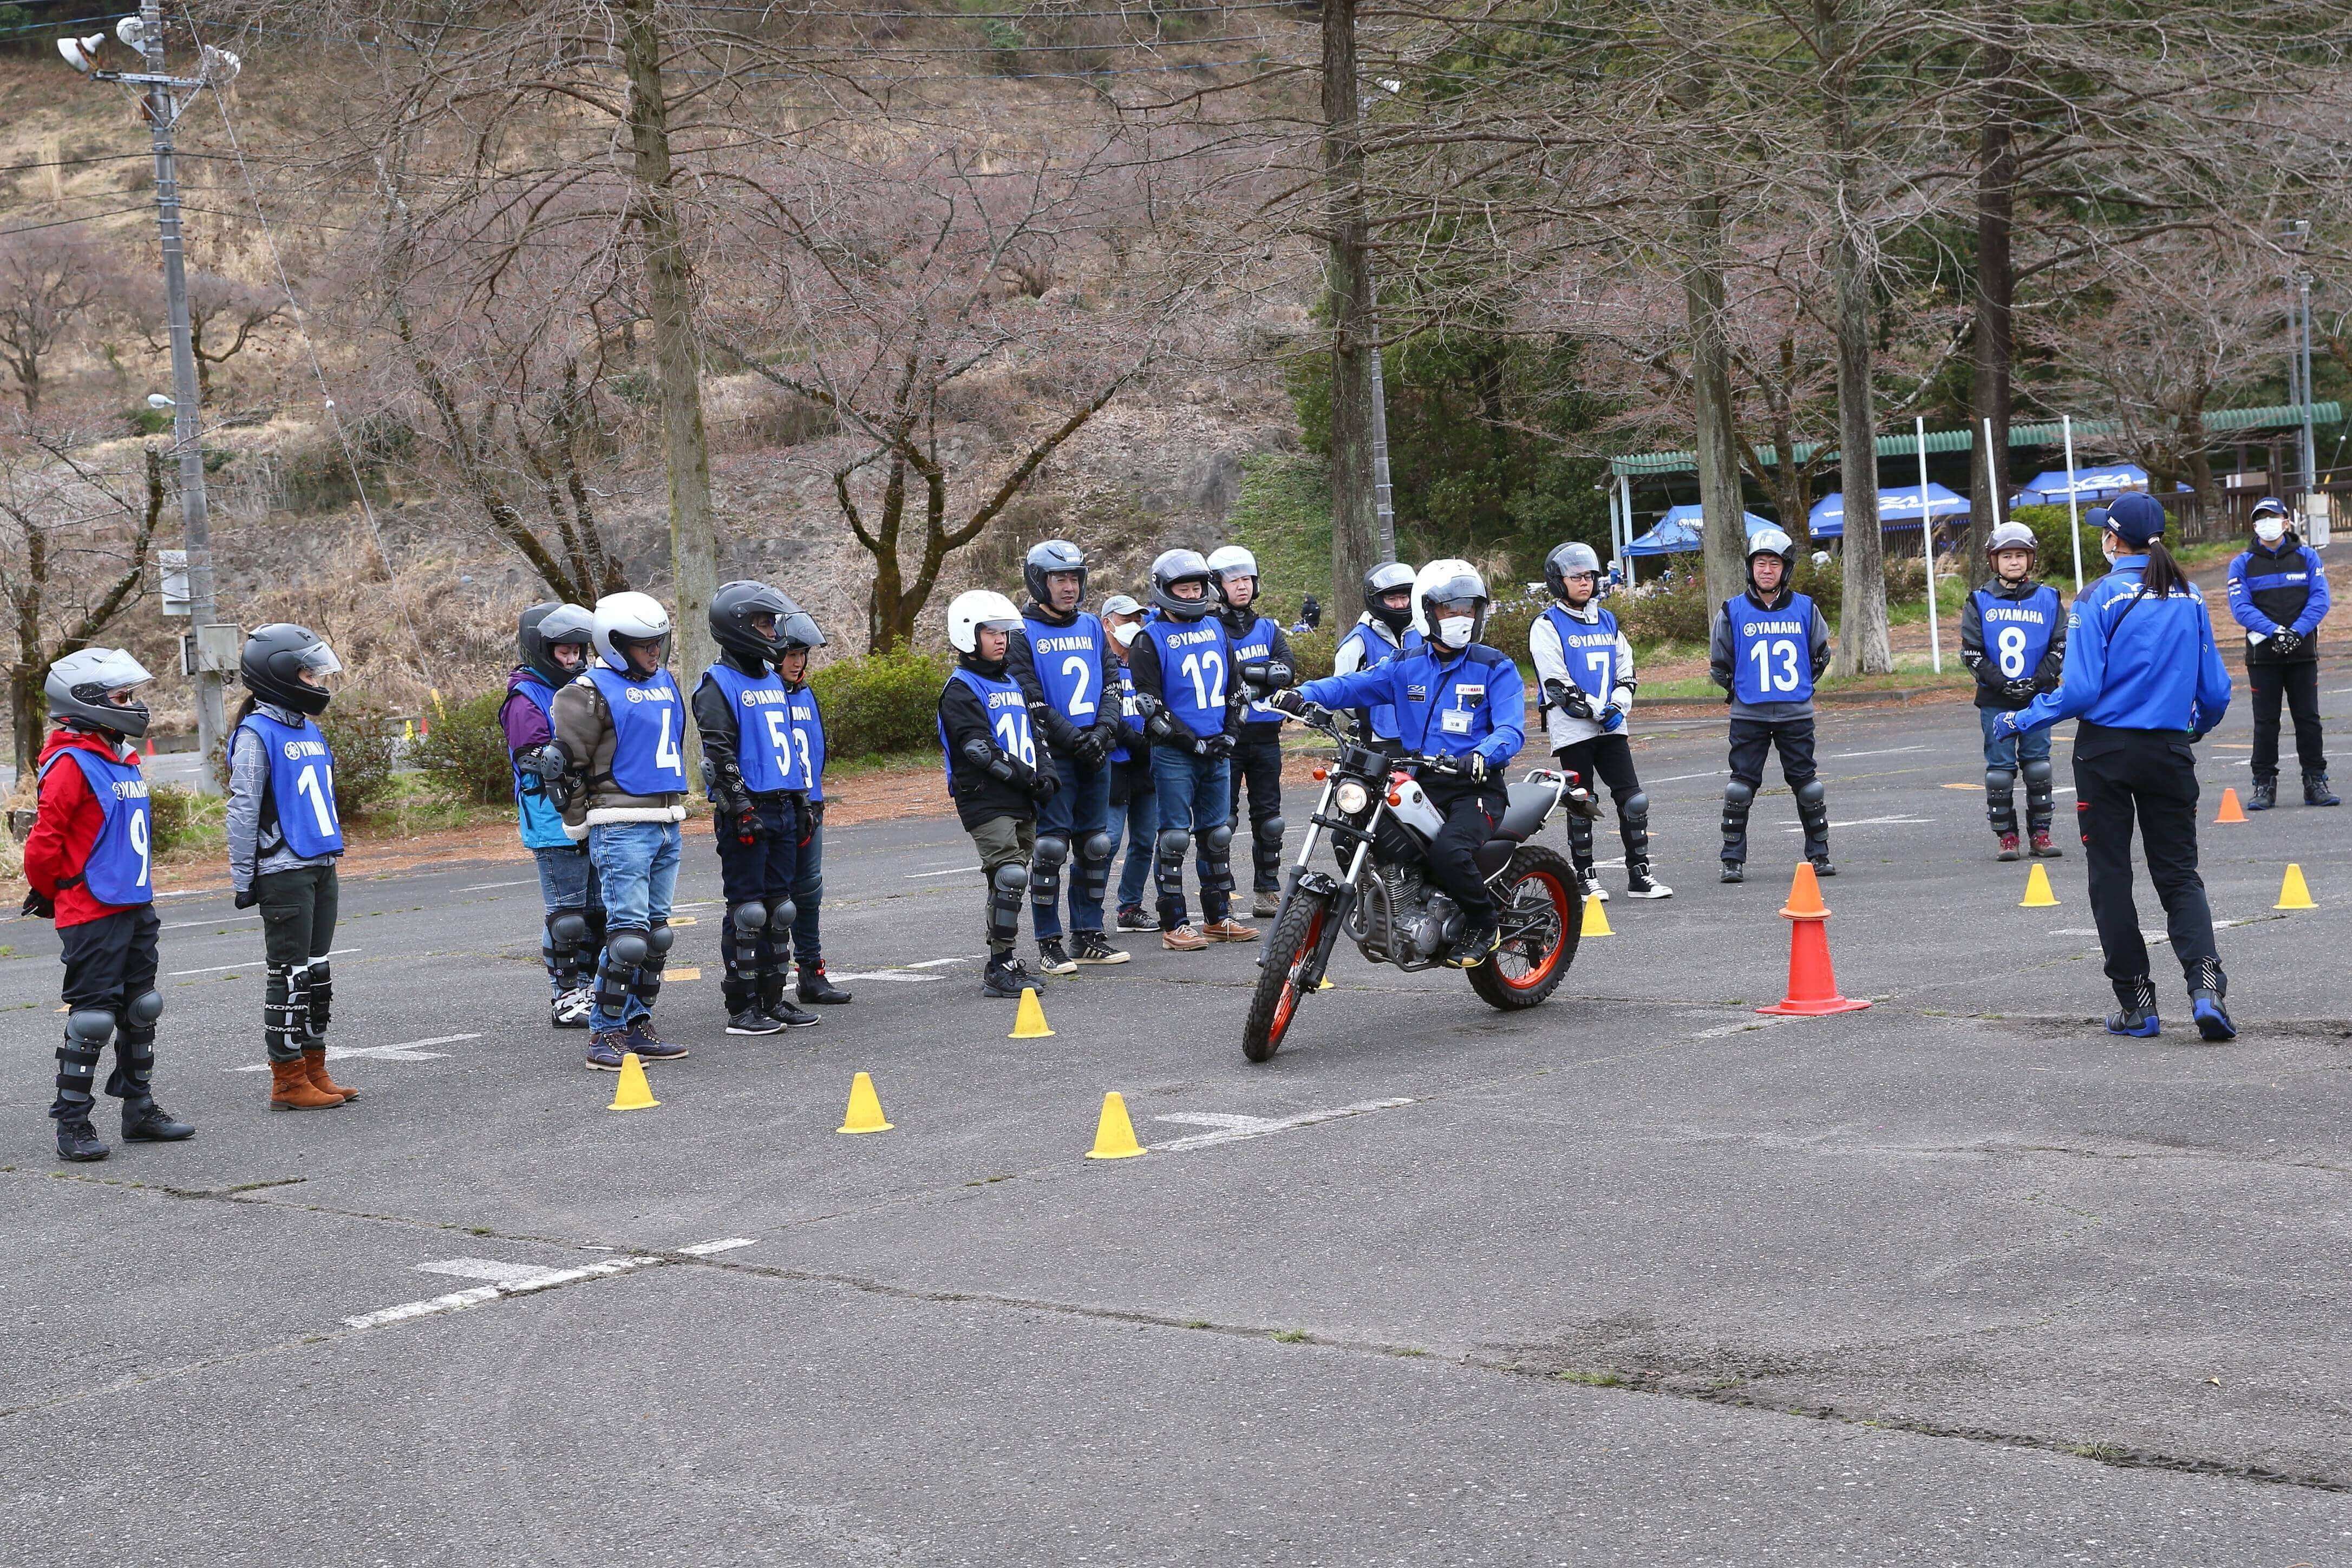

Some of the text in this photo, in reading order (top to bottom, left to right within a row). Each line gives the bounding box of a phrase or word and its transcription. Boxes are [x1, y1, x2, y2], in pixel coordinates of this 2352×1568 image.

[1049, 636, 1094, 651] YAMAHA
[1179, 629, 1217, 646] YAMAH
[1757, 621, 1802, 635] YAMAHA
[1997, 608, 2044, 625] YAMAHA
[1234, 644, 1270, 662] AMAHA
[1586, 651, 1610, 708] 7
[1750, 639, 1799, 692] 13
[1997, 626, 2027, 678] 8
[1062, 656, 1095, 716] 2
[1181, 650, 1226, 710] 12
[655, 708, 682, 776] 4
[764, 710, 792, 776] 5
[996, 713, 1037, 773] 16
[129, 808, 148, 887] 9
